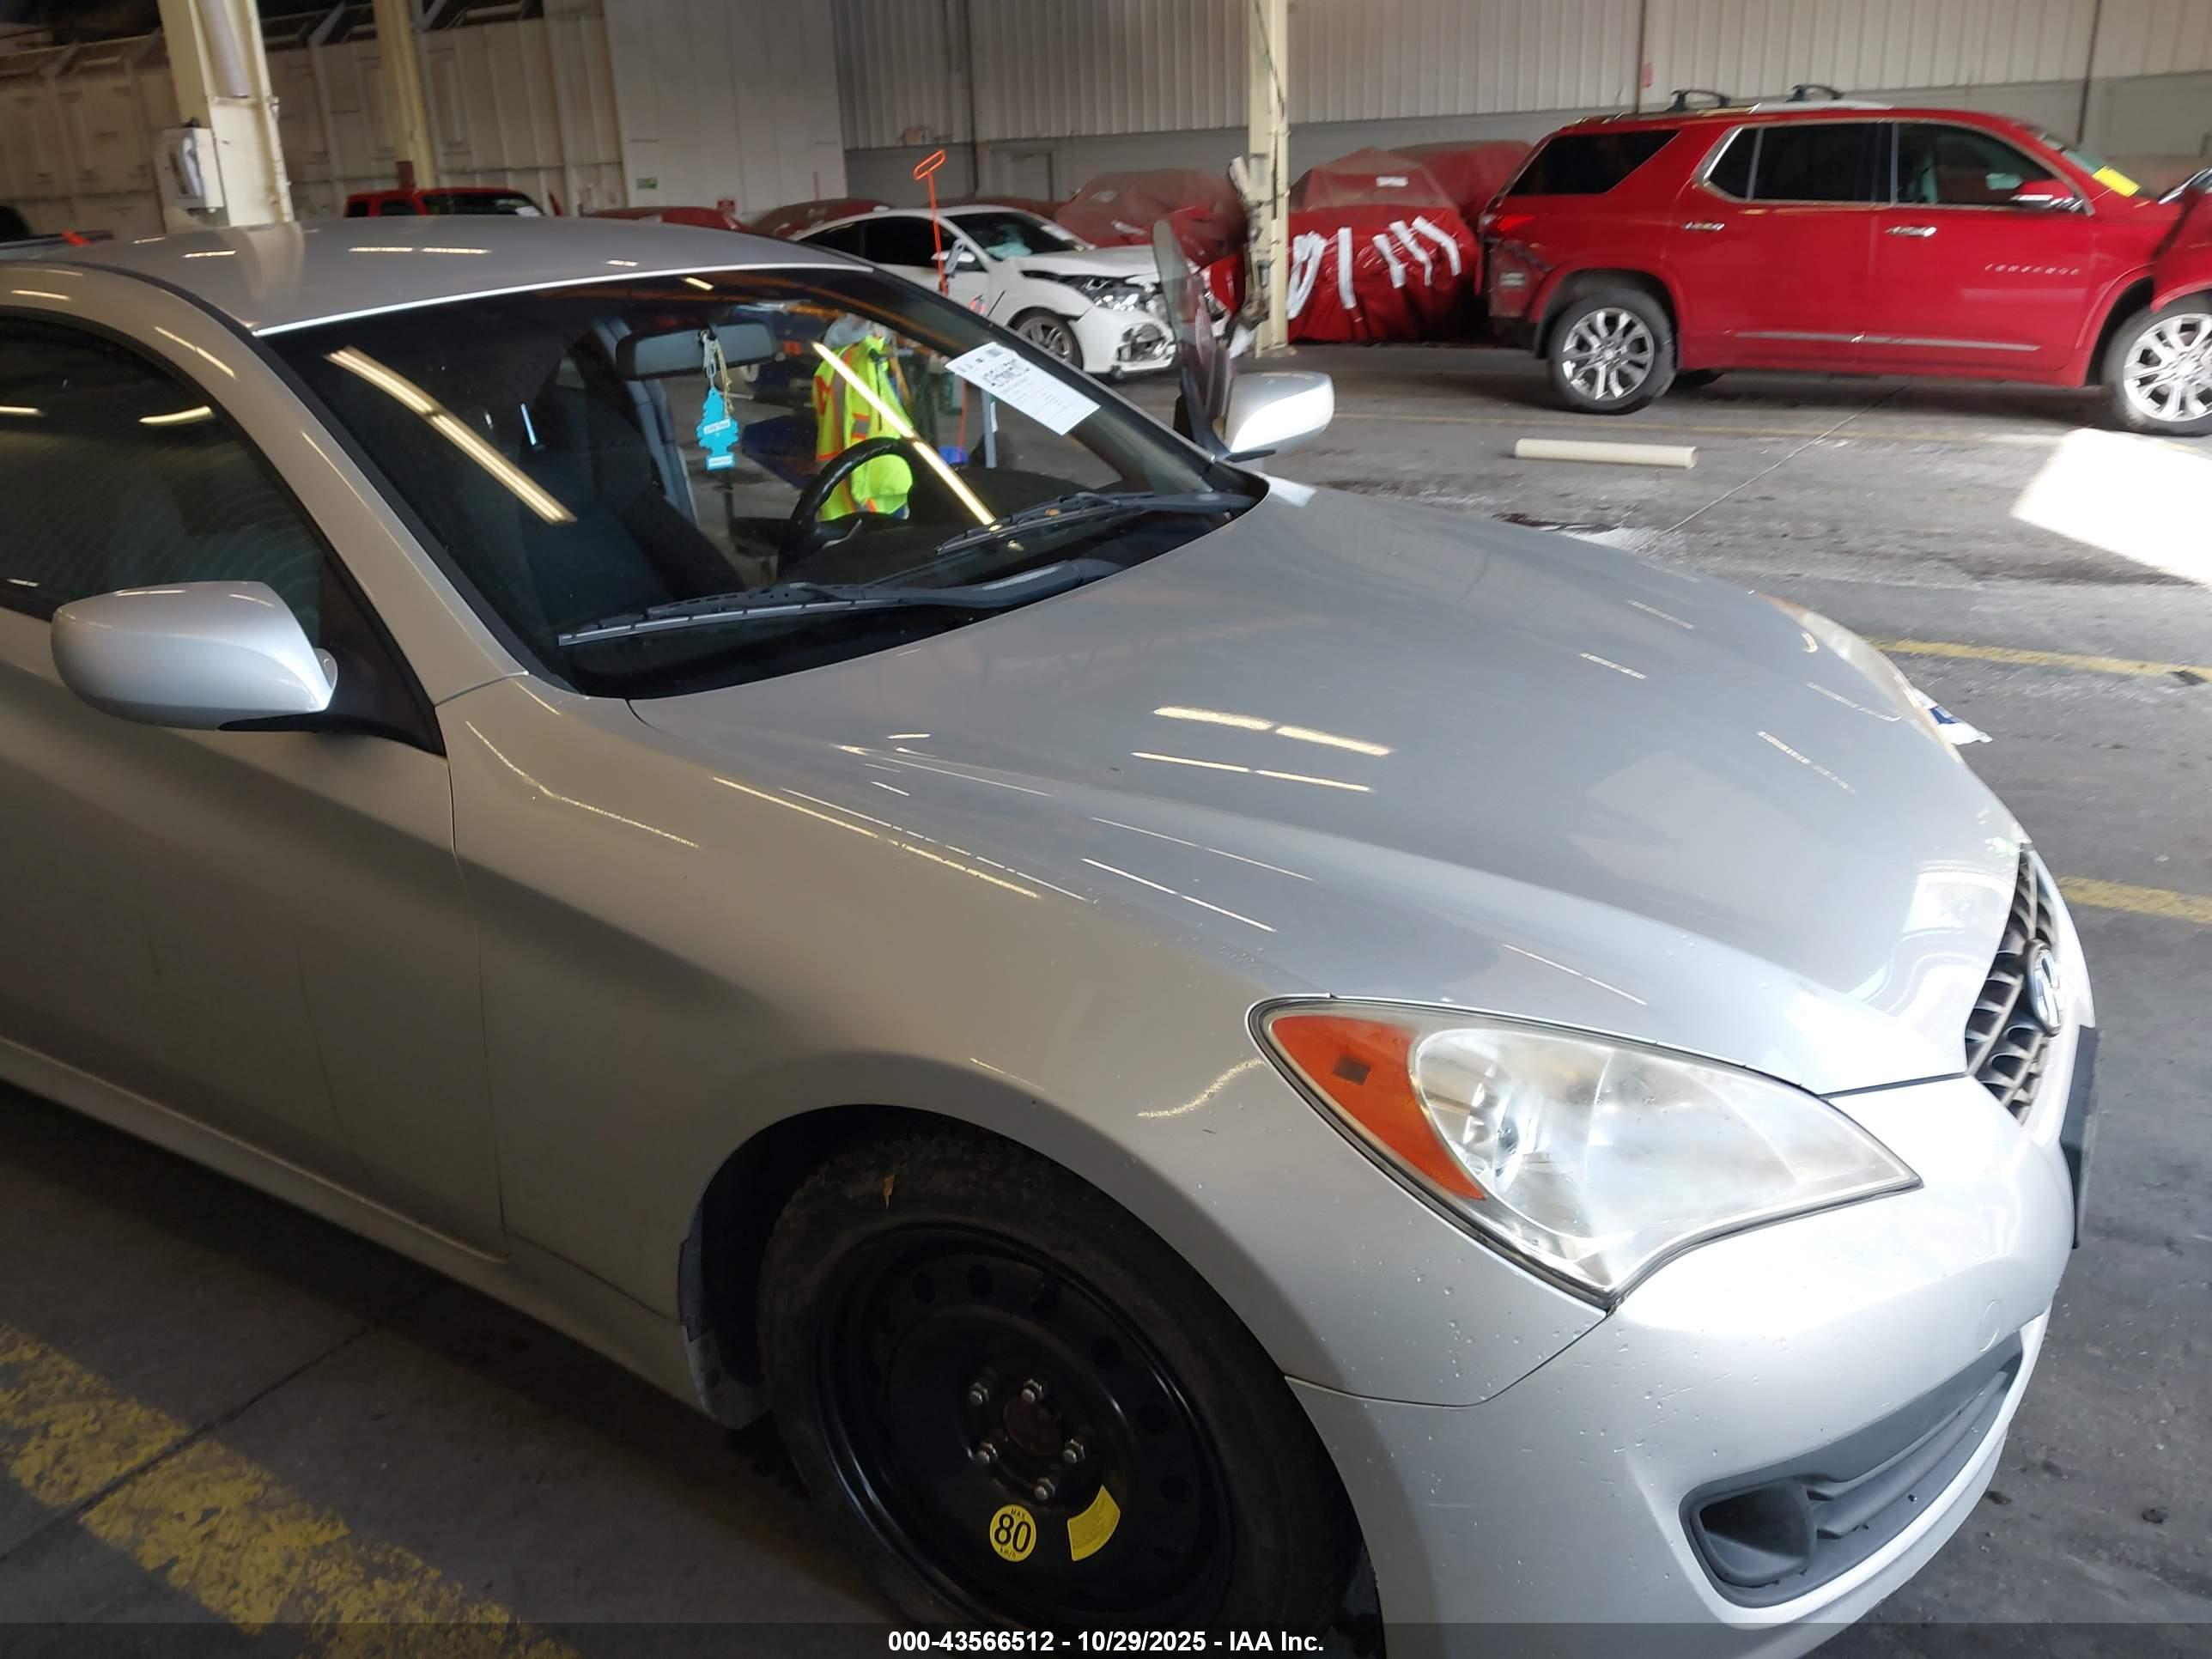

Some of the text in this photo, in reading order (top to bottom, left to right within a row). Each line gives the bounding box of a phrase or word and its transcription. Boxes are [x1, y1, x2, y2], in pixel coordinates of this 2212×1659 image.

[1010, 1508, 1026, 1519] MAX
[994, 1514, 1031, 1553] 80
[1000, 1546, 1017, 1559] km/h
